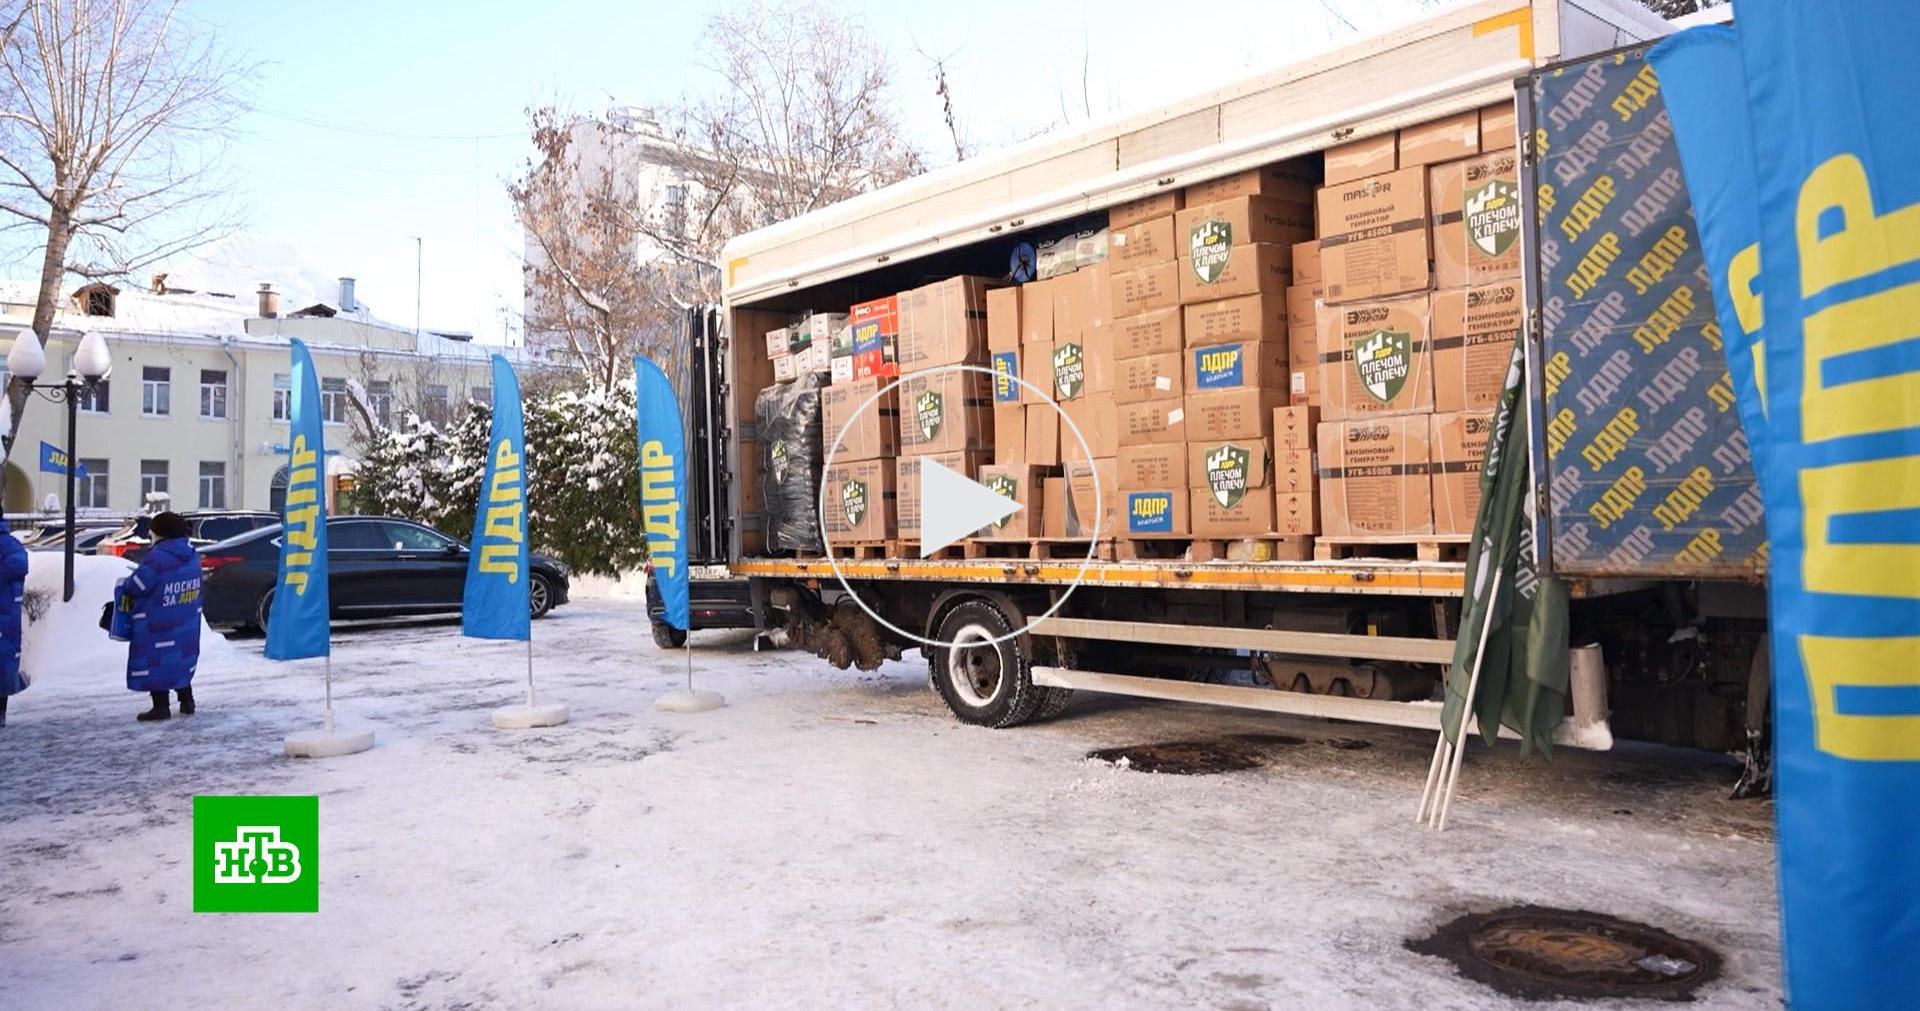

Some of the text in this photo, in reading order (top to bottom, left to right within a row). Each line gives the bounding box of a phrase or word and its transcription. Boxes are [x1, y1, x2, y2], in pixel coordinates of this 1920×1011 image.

[1548, 63, 1607, 131] ЛДПР
[1611, 64, 1660, 122] ЛДП
[1345, 205, 1394, 221] БЕНЗИНОВЫЙ
[1350, 215, 1390, 229] ГЕНЕРАТОР
[1470, 204, 1516, 228] ПЛЕЧОМ
[1560, 175, 1617, 243] ЛДПР
[1619, 167, 1681, 237] ЛДПР
[1193, 242, 1226, 258] ПЛЕЧОМ
[1474, 217, 1519, 239] К ПЛЕЧУ
[1201, 250, 1228, 267] ПЛЕЧУ
[1565, 232, 1622, 300] ЛДПР
[1625, 225, 1689, 295] ЛДПР
[855, 324, 879, 343] ЛДПР
[1469, 318, 1514, 330] ГЕНЕРАТОР
[1568, 290, 1627, 357] ЛДПР
[1632, 285, 1697, 354] ЛДПР
[1200, 350, 1238, 373] ЛДПР
[1361, 354, 1403, 375] ПЛЕЧОМ
[1366, 364, 1408, 386] К ПЛЕЧУ
[1545, 351, 1572, 400] ДПР
[1576, 349, 1634, 416] ЛДПР
[1637, 346, 1701, 414] ЛДПР
[1345, 445, 1395, 456] БЕНЗИНОВЫЙ
[1547, 407, 1577, 460] ДПР
[1581, 406, 1641, 472] ЛДПР
[1644, 406, 1709, 473] ЛДПР
[49, 452, 68, 466] ЛД
[1210, 468, 1242, 482] ПЛЕЧОМ
[1219, 477, 1245, 490] ПЛЕЧУ
[1350, 455, 1390, 464] ГЕНЕРАТОР
[286, 434, 320, 596] ЛДПР
[479, 438, 524, 585] ЛДПР
[642, 440, 681, 578] ЛДПР
[1133, 498, 1168, 517] ЛДПР
[1550, 465, 1584, 517] ДПР
[1588, 465, 1648, 530] ЛДПР
[1652, 465, 1716, 532] ЛДПР
[162, 595, 176, 606] ЗА
[164, 577, 200, 594] МОСКВА
